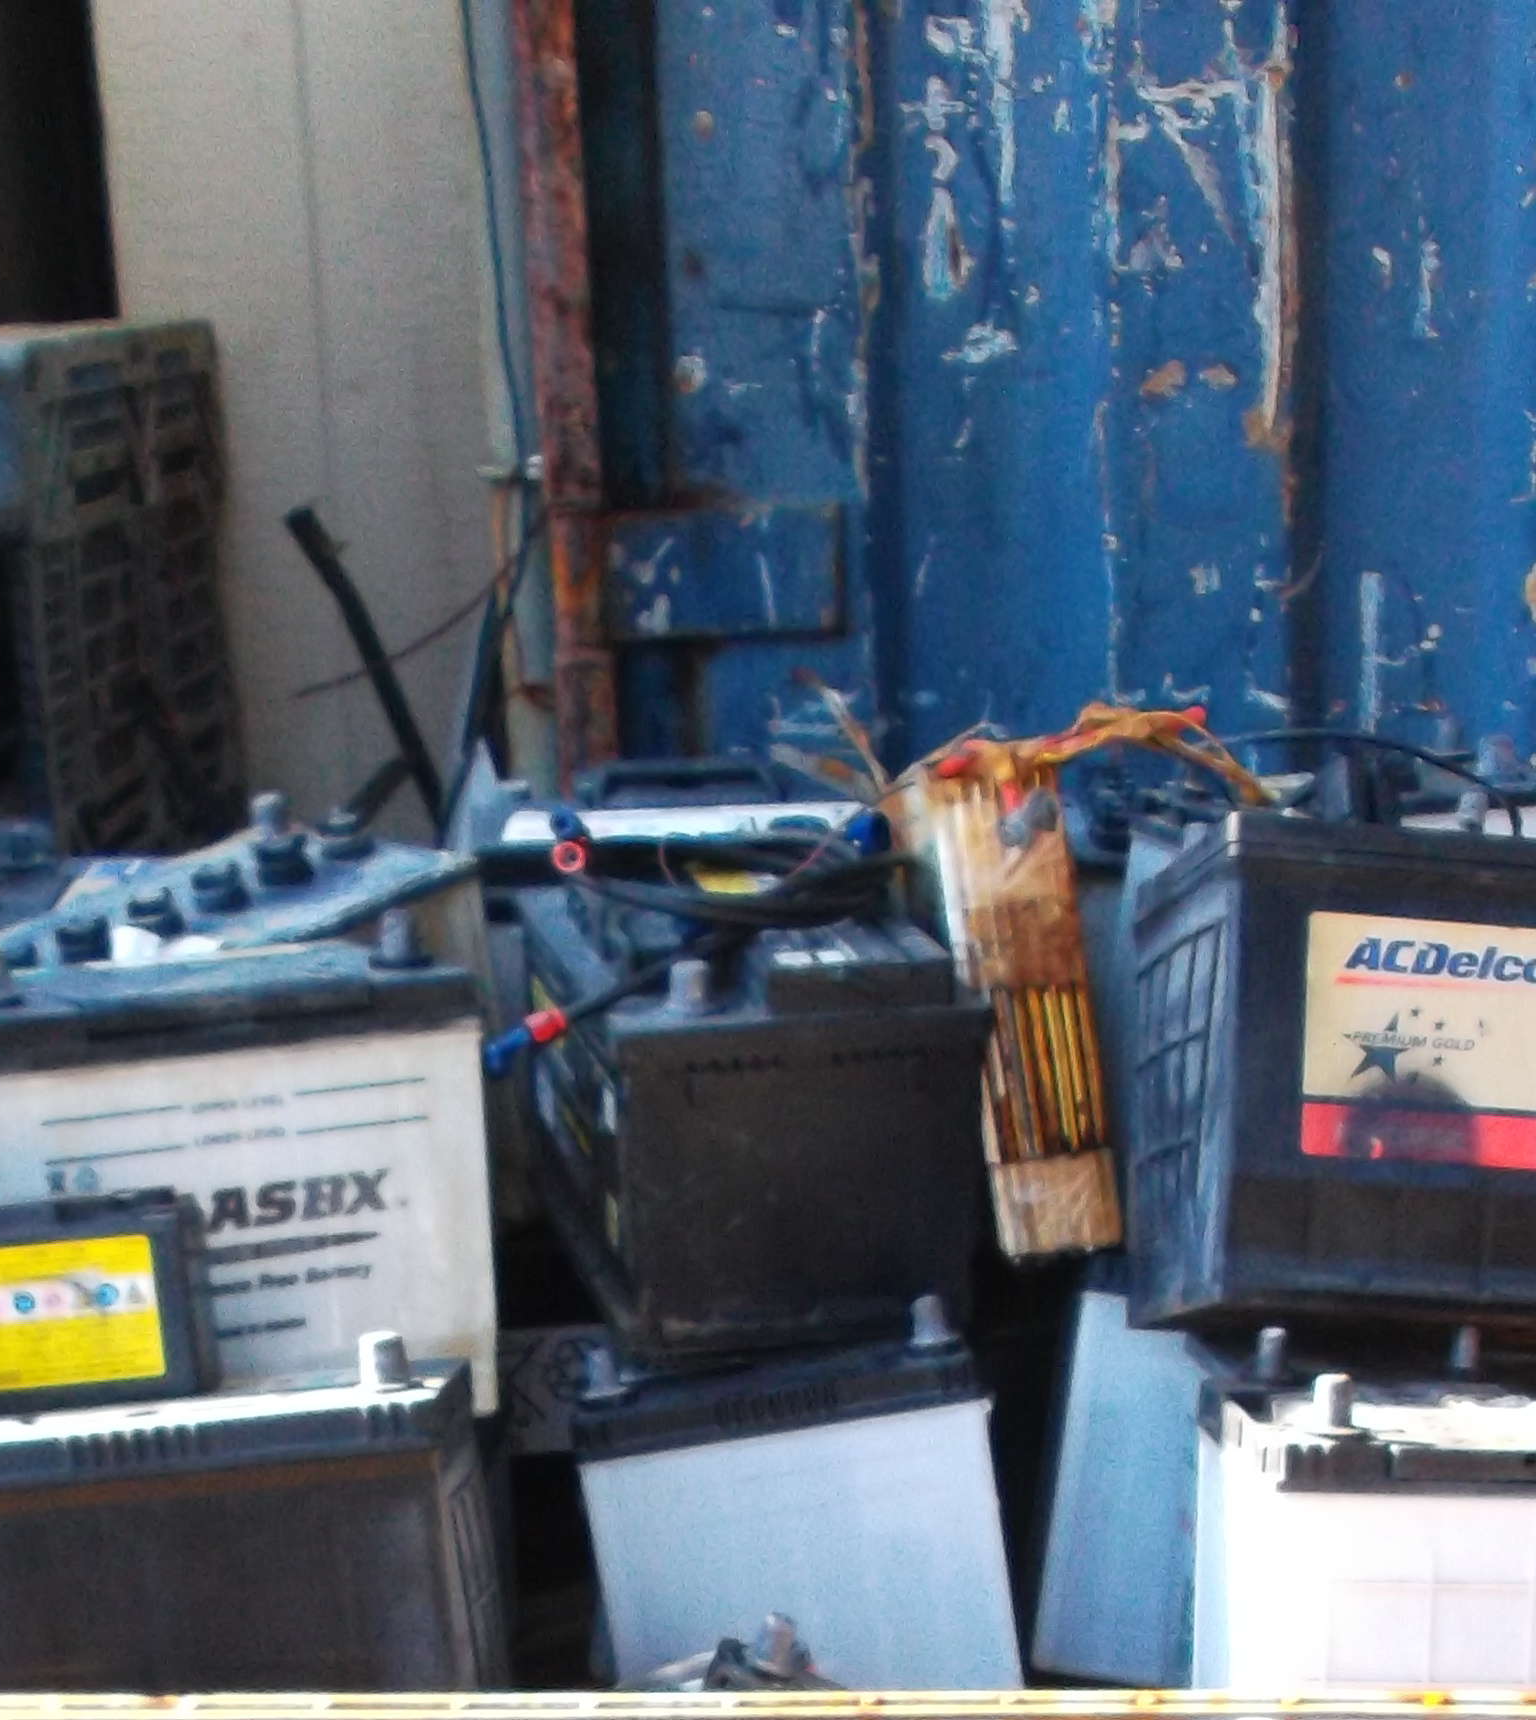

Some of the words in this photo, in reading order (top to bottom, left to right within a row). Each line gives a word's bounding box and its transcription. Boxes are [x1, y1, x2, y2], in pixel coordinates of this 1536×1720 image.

[1352, 1031, 1427, 1050] PREMIUM
[1432, 1036, 1476, 1051] GOLD
[207, 1167, 391, 1233] ASBX
